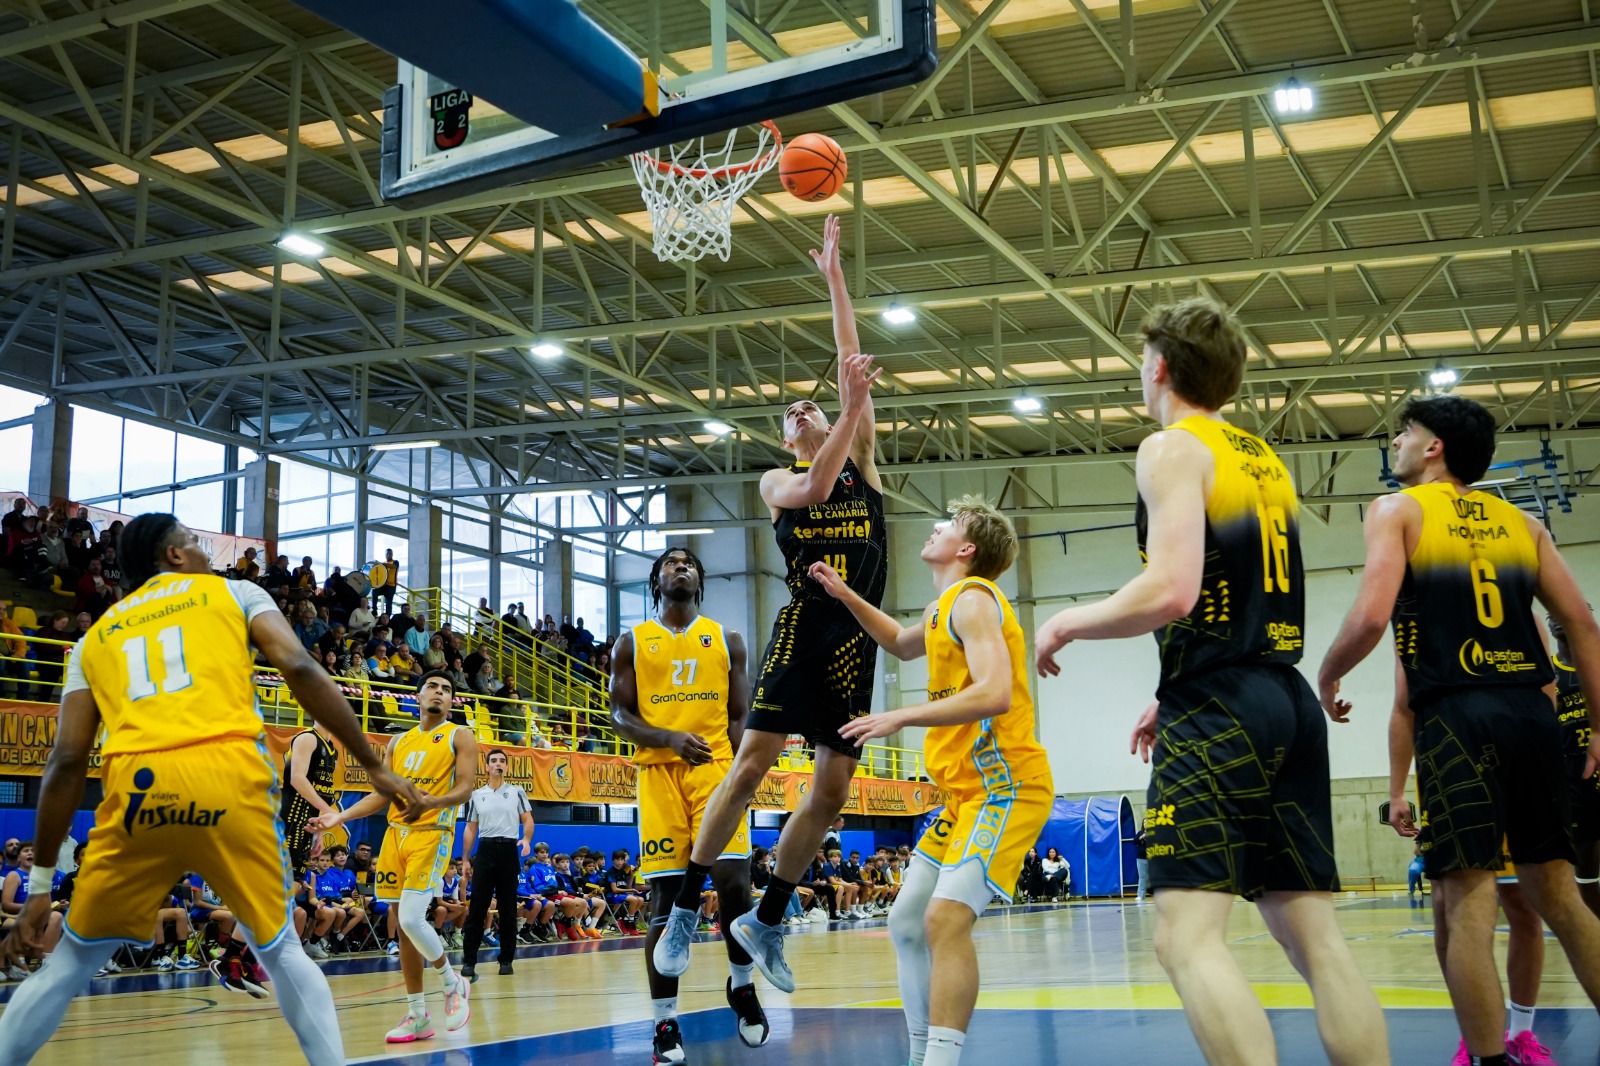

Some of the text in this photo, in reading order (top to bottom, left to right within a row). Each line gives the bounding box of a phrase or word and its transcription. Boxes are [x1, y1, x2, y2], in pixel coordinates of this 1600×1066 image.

[434, 90, 470, 111] LIGA
[809, 508, 869, 520] CB CANARIAS
[1470, 558, 1504, 629] 6
[126, 597, 198, 627] CaixaBank
[121, 625, 193, 702] 11
[1485, 649, 1524, 664] gasten
[671, 658, 697, 686] 27
[404, 750, 427, 771] 41
[151, 791, 181, 802] viajes
[641, 837, 675, 858] IOC
